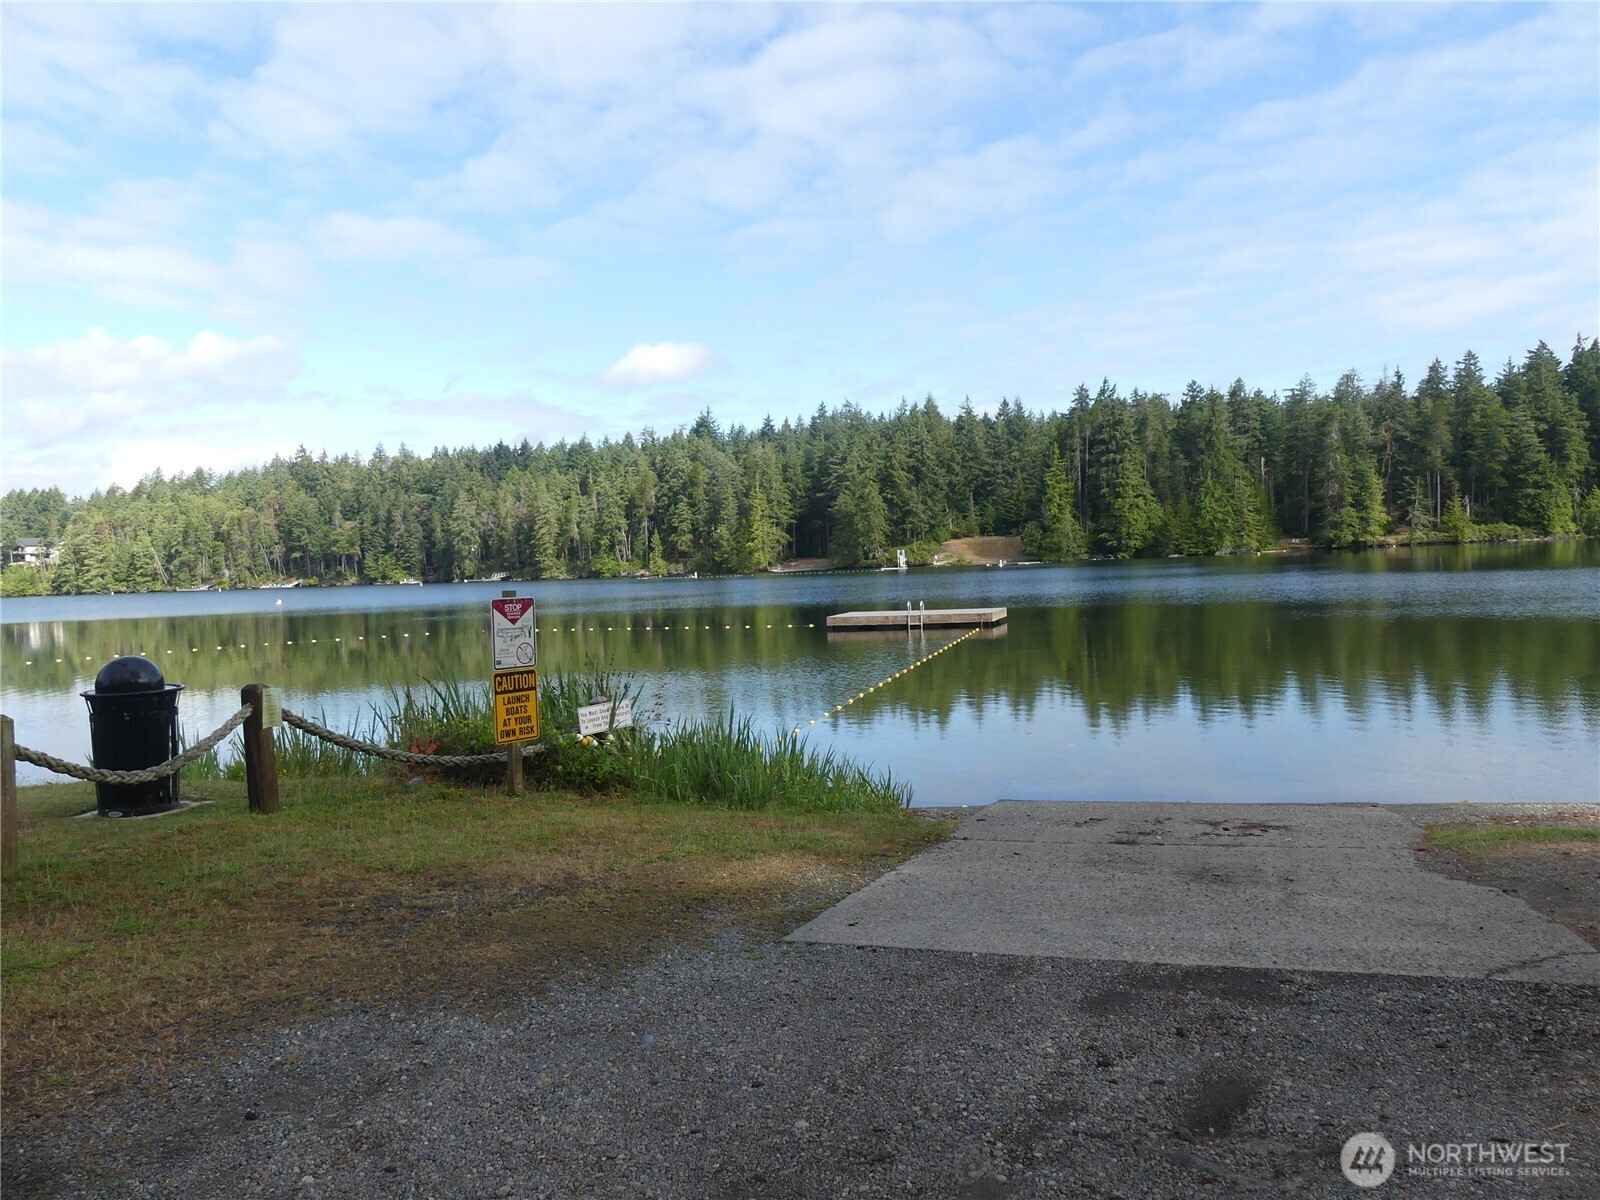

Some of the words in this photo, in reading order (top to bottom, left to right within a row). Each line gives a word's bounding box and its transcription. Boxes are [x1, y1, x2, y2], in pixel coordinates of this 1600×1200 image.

[504, 603, 522, 612] STOP
[495, 673, 535, 692] CAUTION
[502, 694, 530, 706] LAUNCH
[505, 705, 528, 716] BOATS
[502, 718, 511, 727] AT
[514, 715, 532, 726] YOUR
[500, 728, 516, 739] OWN
[519, 725, 535, 736] RISK
